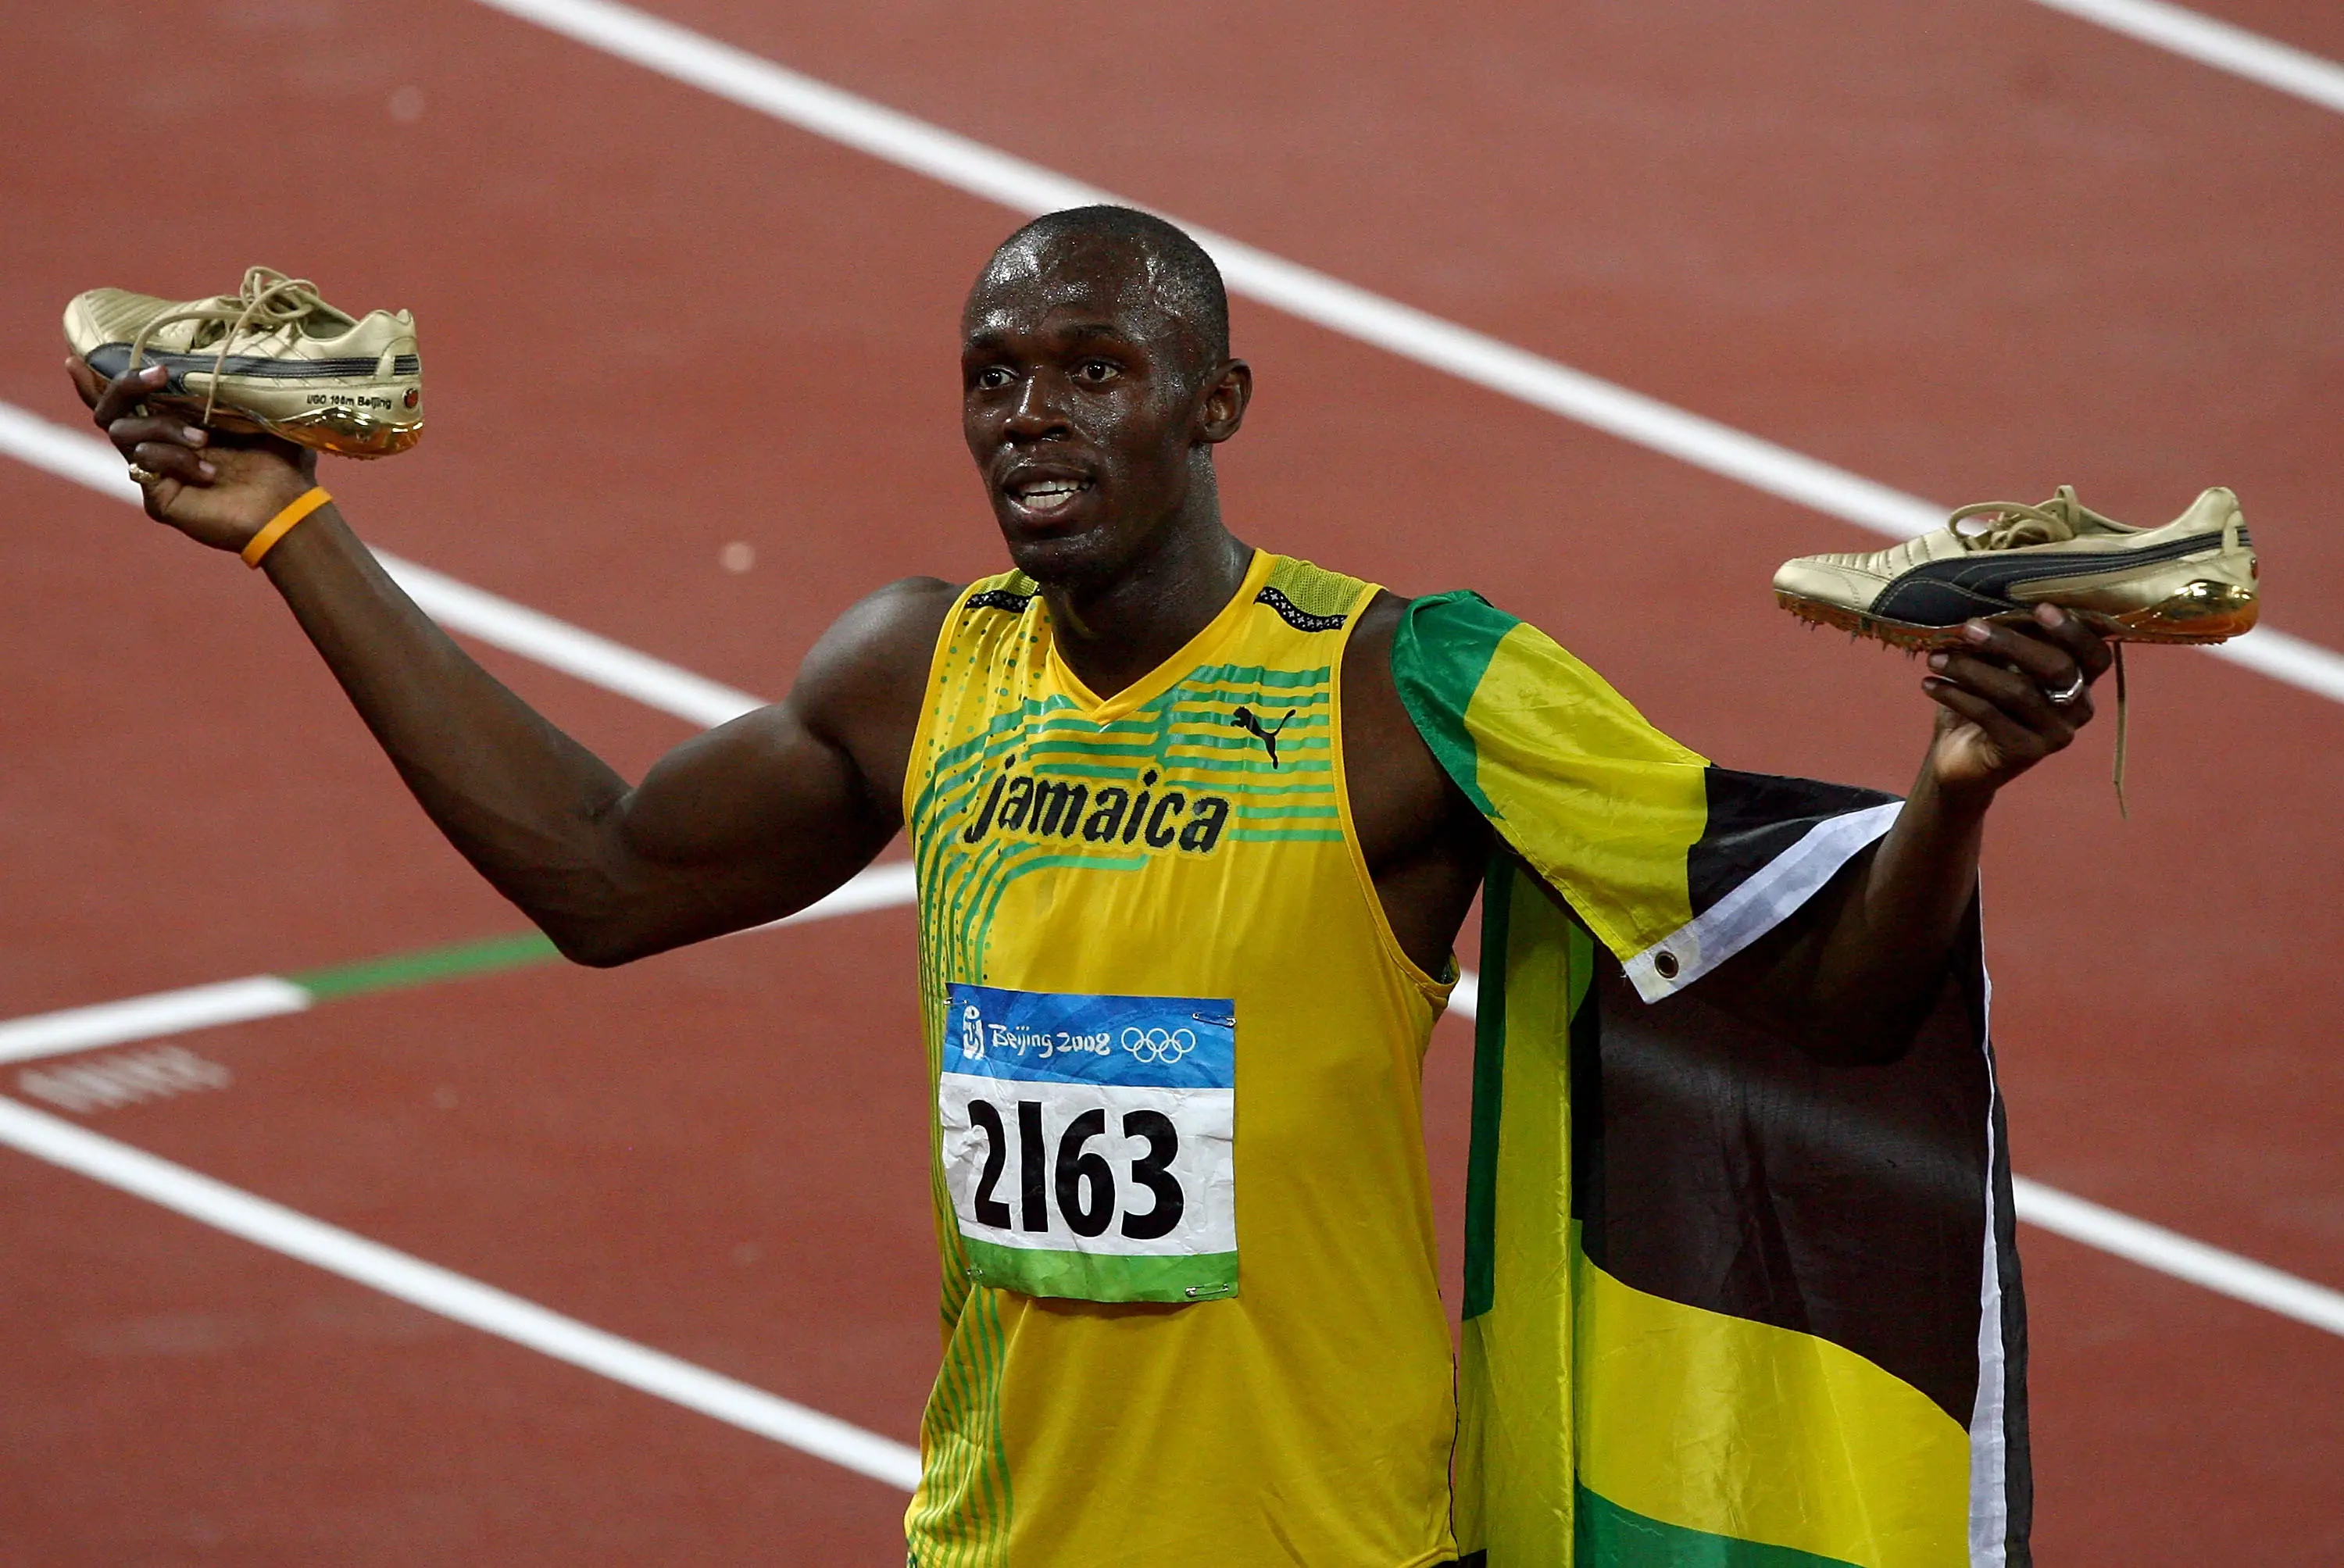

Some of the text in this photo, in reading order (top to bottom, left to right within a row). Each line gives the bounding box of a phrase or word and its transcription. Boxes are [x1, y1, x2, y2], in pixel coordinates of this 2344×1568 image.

[330, 395, 355, 405] 100m
[357, 396, 392, 409] Beijing
[963, 754, 1230, 852] jamaica
[988, 1023, 1110, 1059] Beijing 2008
[967, 1099, 1185, 1240] 2163
